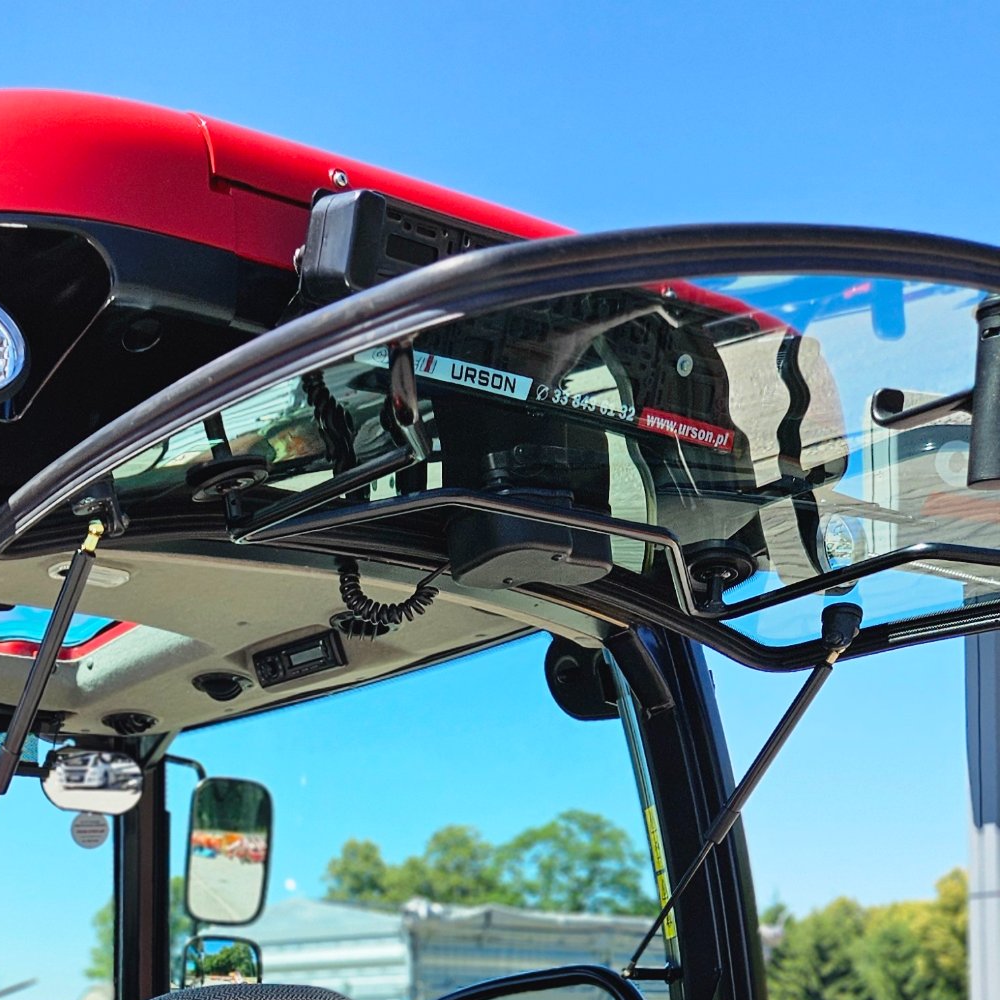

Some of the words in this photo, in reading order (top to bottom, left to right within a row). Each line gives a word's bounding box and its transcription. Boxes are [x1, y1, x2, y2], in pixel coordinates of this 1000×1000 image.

[451, 363, 517, 394] URSON
[551, 389, 569, 405] 33
[618, 404, 636, 422] 32
[646, 414, 729, 447] www.urson.pl
